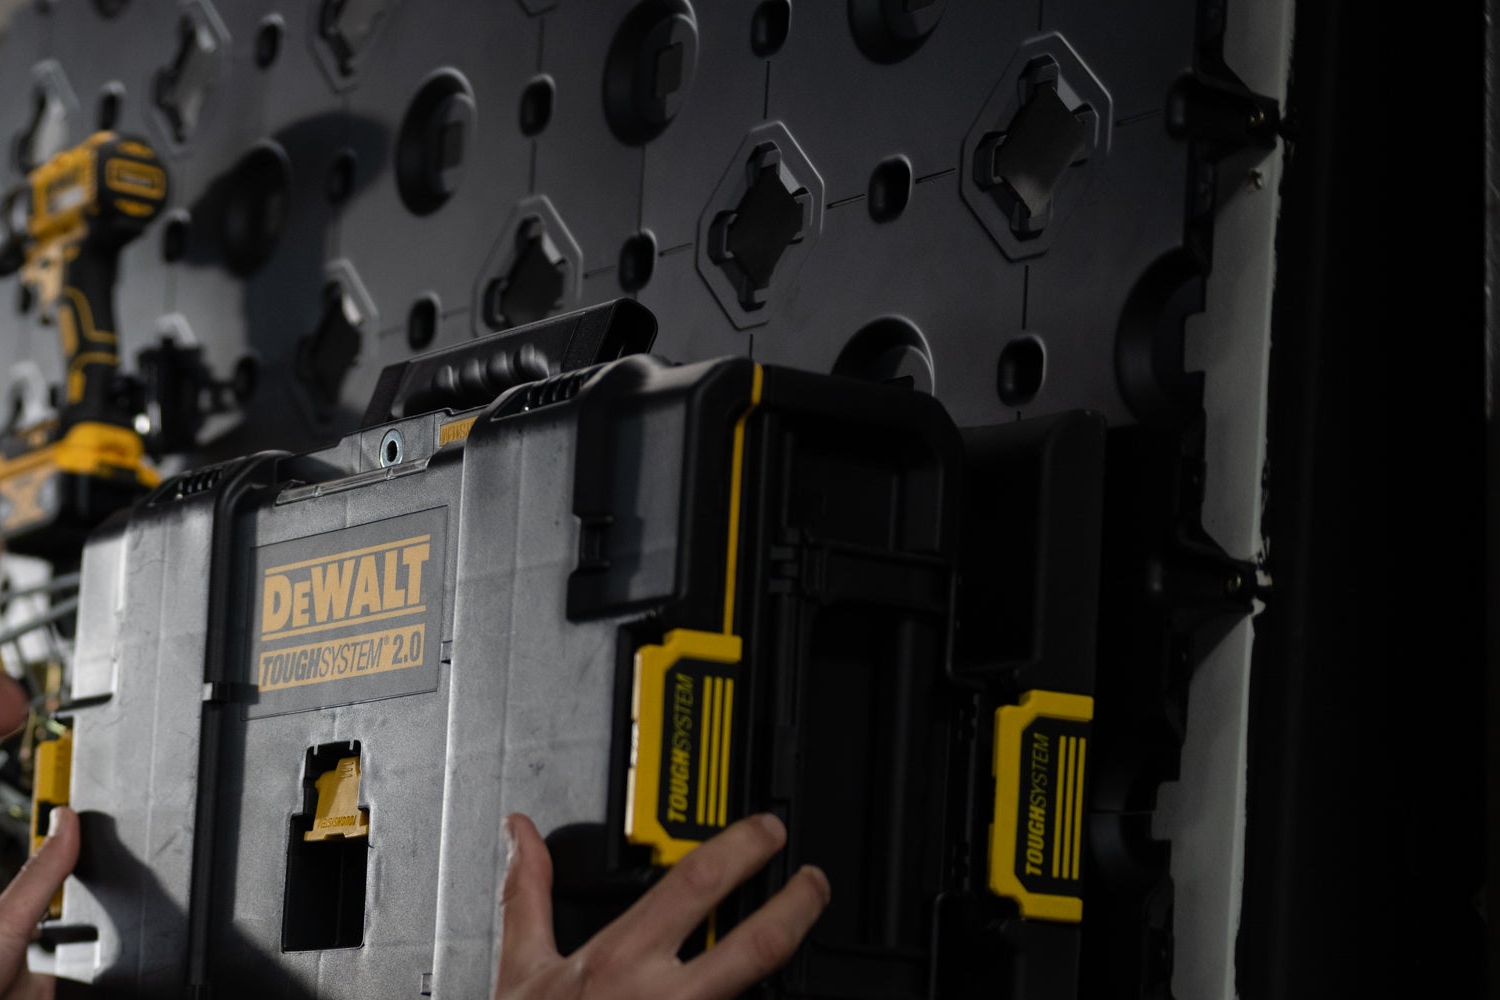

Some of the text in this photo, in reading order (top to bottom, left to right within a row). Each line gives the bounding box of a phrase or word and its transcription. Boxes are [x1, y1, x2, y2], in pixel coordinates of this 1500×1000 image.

[391, 630, 422, 665] 2.0
[666, 672, 695, 824] TOUGHSYSTEM
[1025, 732, 1050, 877] TOUGHSYSTEM
